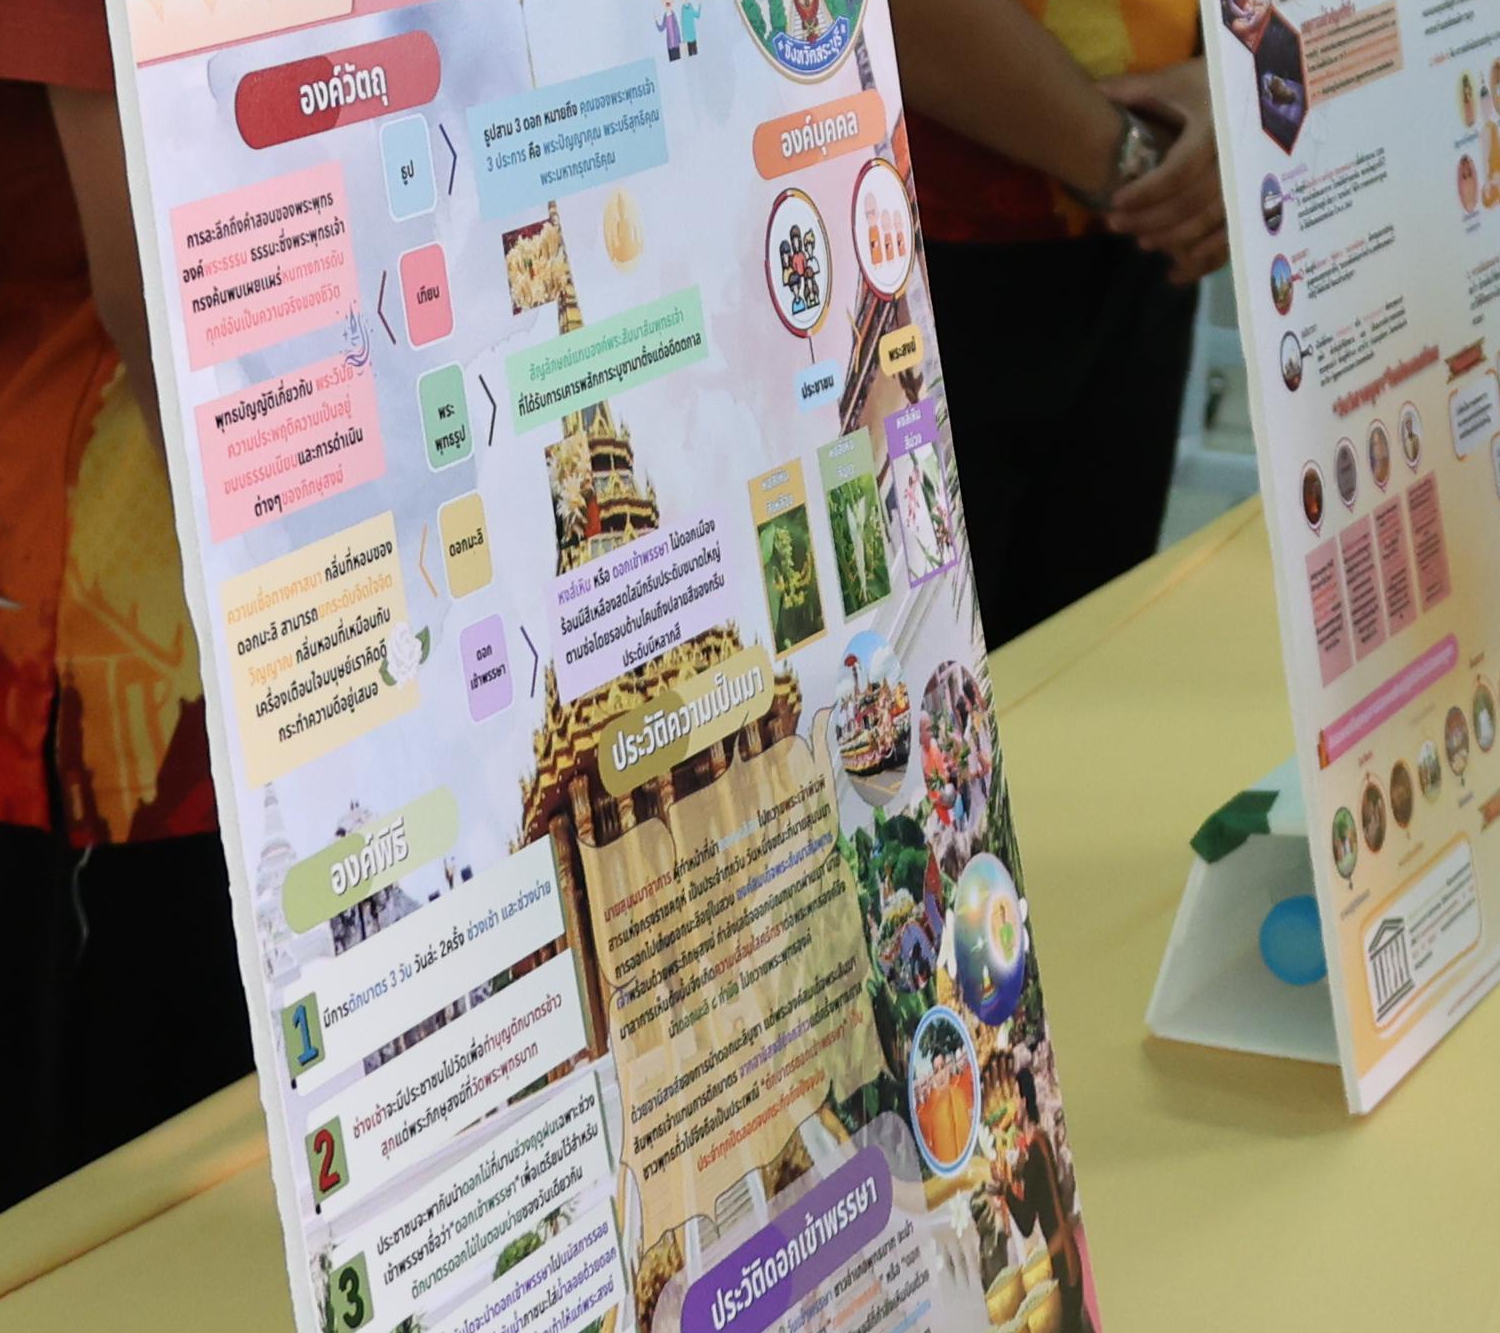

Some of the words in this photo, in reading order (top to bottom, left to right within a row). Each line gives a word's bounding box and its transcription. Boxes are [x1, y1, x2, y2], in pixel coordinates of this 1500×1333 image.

[299, 63, 388, 116] องค์วัตถุ
[483, 120, 513, 148] ธูปสาม
[515, 118, 522, 134] 3
[523, 112, 542, 132] ดอก
[544, 99, 579, 126] หมายถึง
[780, 109, 858, 158] องค์บุคคล
[400, 161, 414, 185] ธูป
[486, 156, 494, 173] 3
[495, 145, 527, 171] ประการ
[528, 140, 542, 160] คือ
[416, 285, 440, 305] เทียน
[801, 374, 835, 399] ประชาชน
[438, 404, 455, 421] พระ
[435, 428, 466, 454] พุทธรูป
[448, 528, 485, 559] ดอกมะลิ
[594, 568, 611, 589] หรือ
[236, 620, 279, 656] ดอกมะลิ
[475, 644, 493, 663] ดอก
[469, 661, 507, 693] เข้าพรรษา
[611, 664, 764, 773] ประวัติความเป็นมา
[330, 817, 409, 895] องค์พิธี
[292, 1003, 320, 1067] 1
[323, 977, 388, 1029] มีการตักบาตร
[390, 972, 398, 989] 3
[399, 963, 413, 984] วัน
[440, 927, 465, 960] 2ครั้ง
[467, 908, 500, 942] ช่วงเช้า
[501, 880, 552, 922] และช่วงบ่าย
[313, 1128, 342, 1193] 2
[709, 1175, 879, 1332] ประวัติดอกเข้าพรรษา
[338, 1265, 361, 1331] 3
